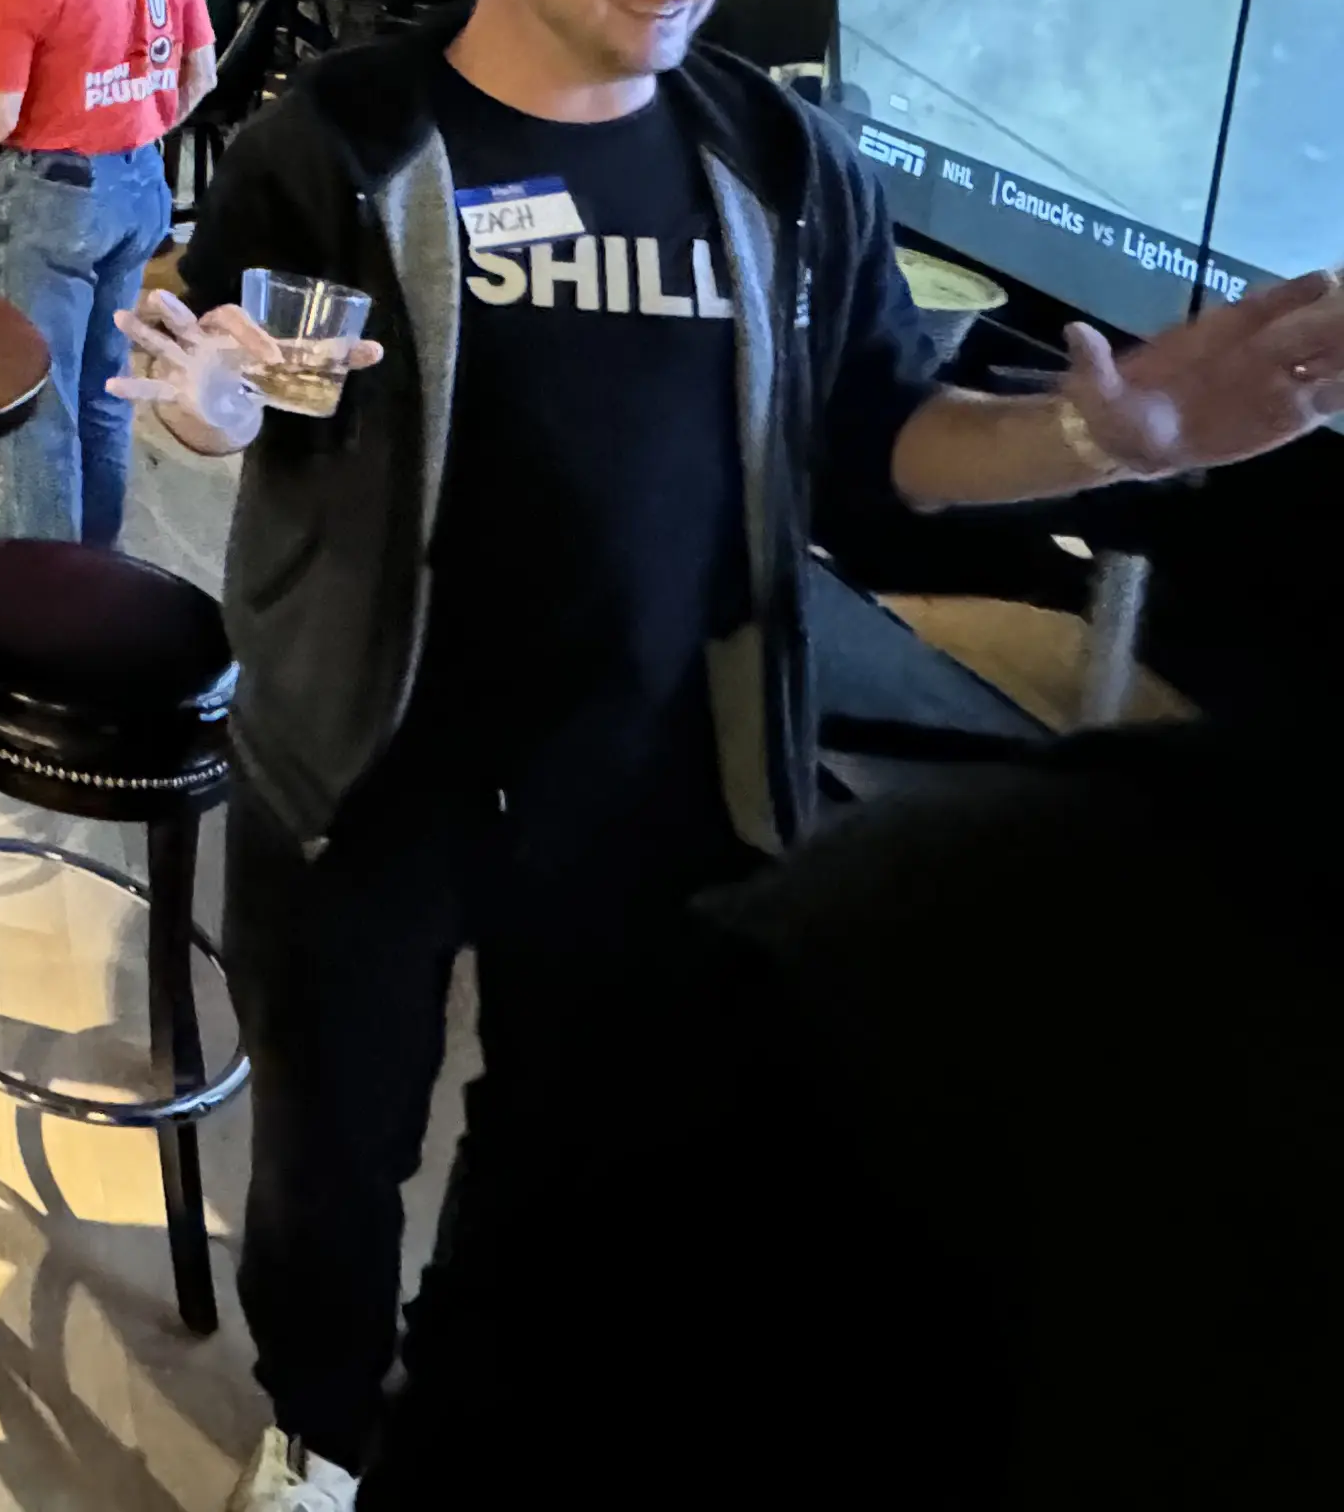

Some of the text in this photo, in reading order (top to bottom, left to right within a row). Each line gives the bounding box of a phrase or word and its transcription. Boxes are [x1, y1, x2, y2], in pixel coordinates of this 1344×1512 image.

[858, 125, 927, 177] ESPN
[468, 203, 536, 234] ZACH
[942, 159, 1248, 303] NHL Canucks vs Lightning
